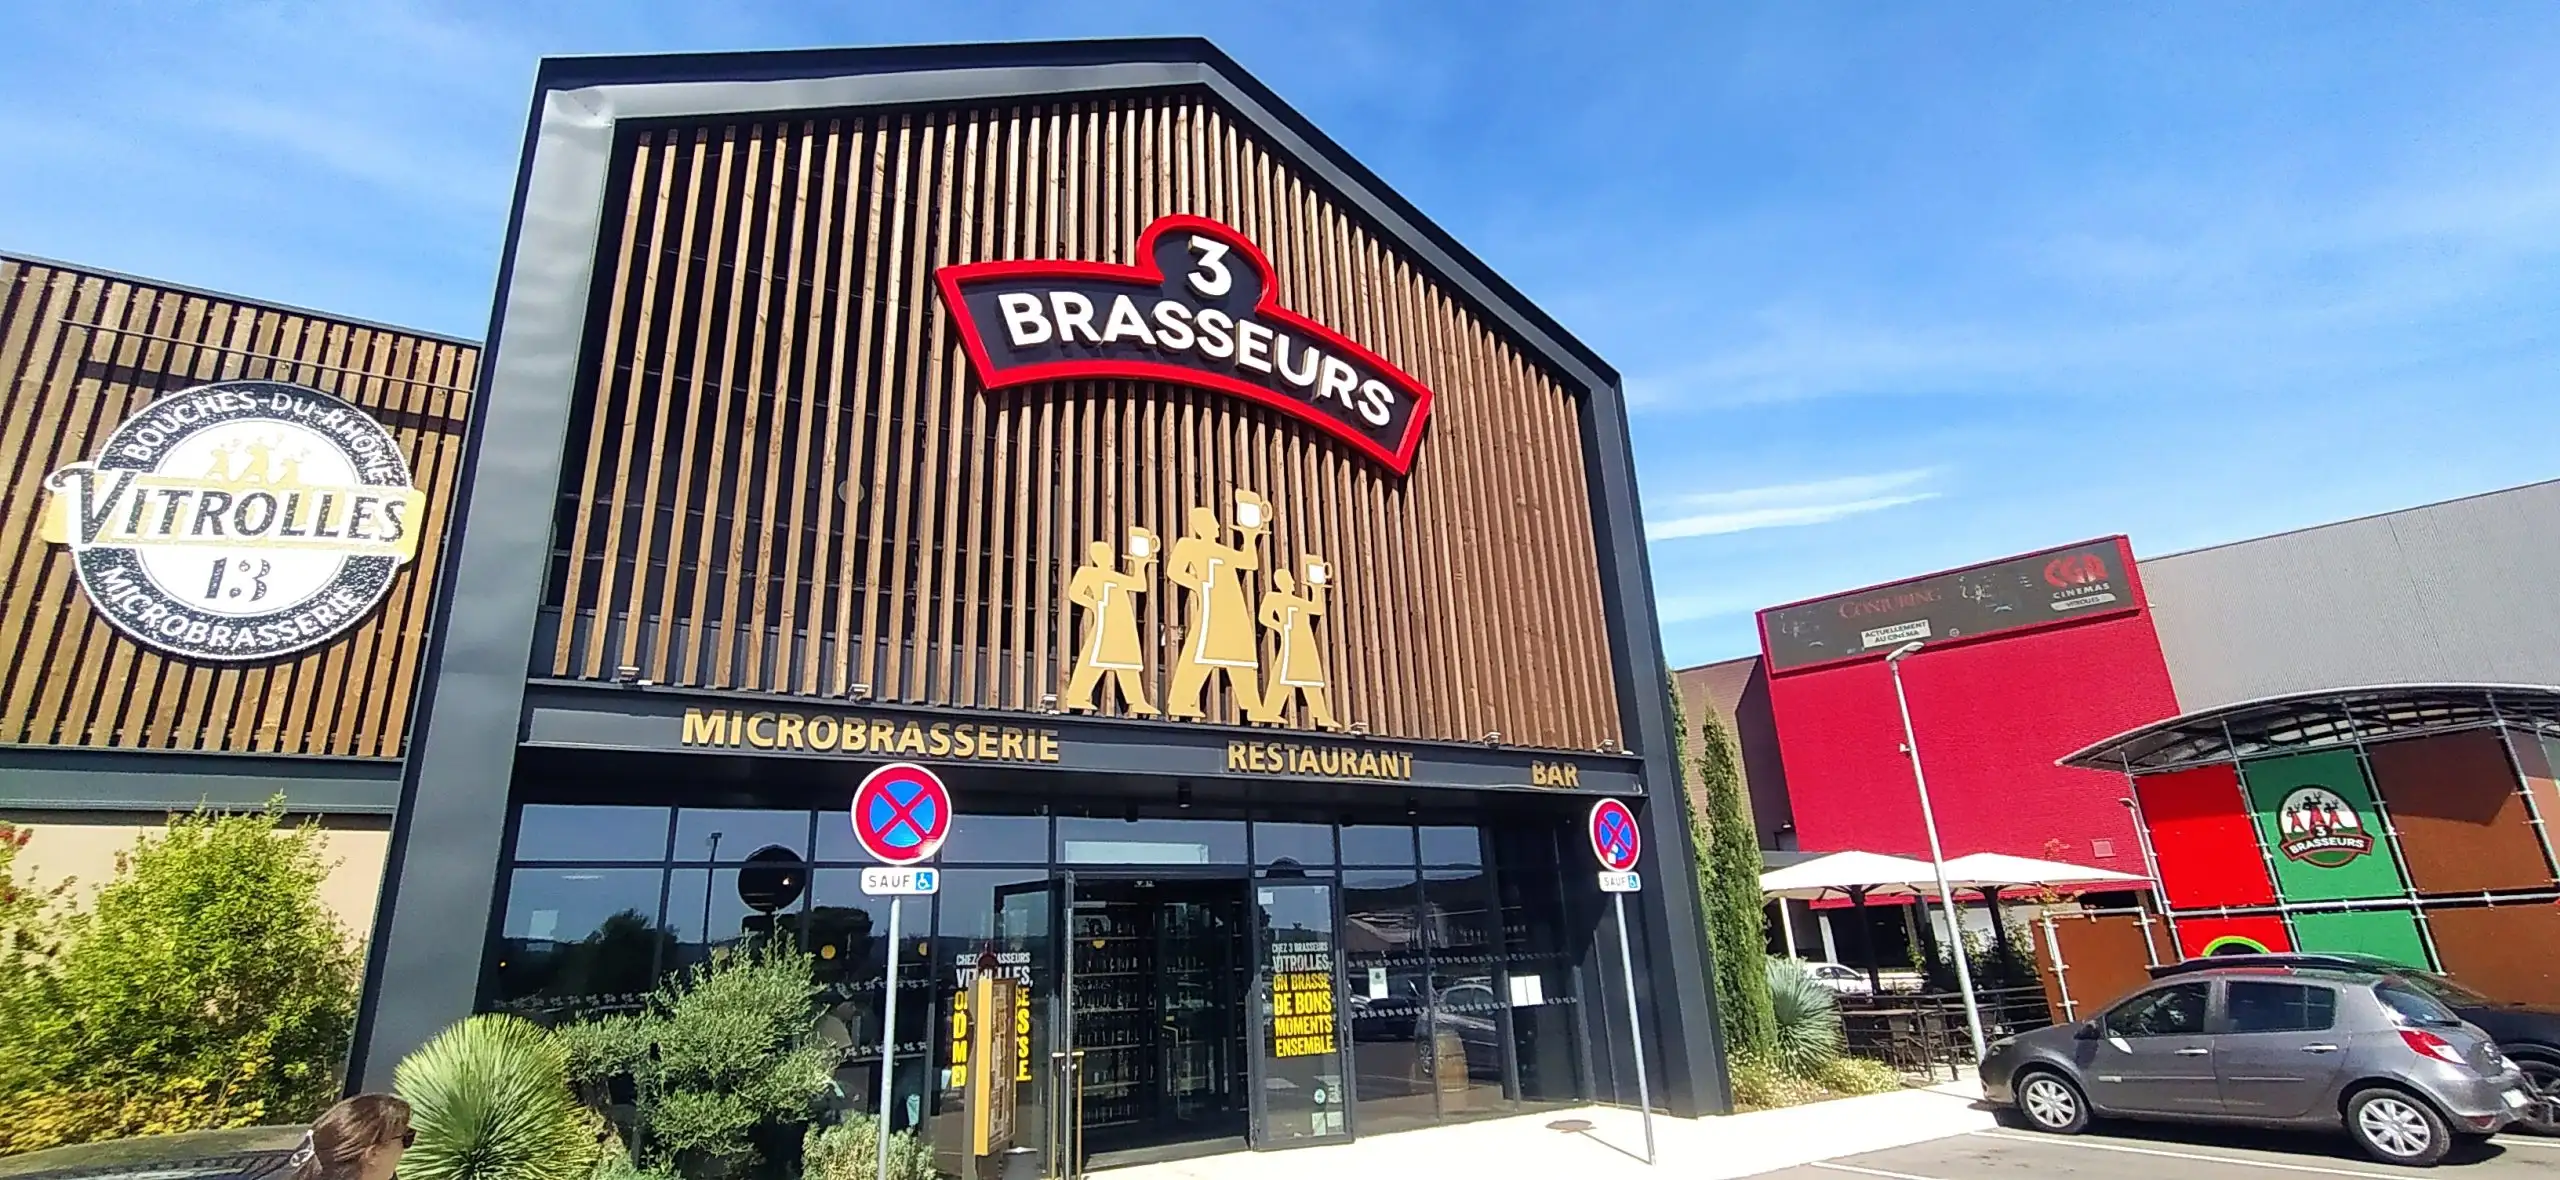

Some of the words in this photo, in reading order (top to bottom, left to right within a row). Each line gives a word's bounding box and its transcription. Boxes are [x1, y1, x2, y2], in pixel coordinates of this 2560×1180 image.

[1186, 234, 1232, 297] 3
[997, 291, 1396, 428] BRASSEURS
[48, 466, 408, 547] VITROLLES
[203, 556, 271, 603] 13
[2052, 582, 2111, 600] CINEMAS
[96, 565, 365, 648] MICROBRASSERIE
[1864, 621, 1927, 639] ACTUELLEMENT
[1874, 635, 1887, 643] AU
[681, 707, 1061, 763] MICROBRASSERIE
[1228, 740, 1414, 780] RESTAURANT
[1530, 760, 1581, 789] BAR
[2316, 825, 2327, 837] 3
[2288, 837, 2366, 854] BRASSEURS
[867, 873, 911, 889] SAUF
[1603, 876, 1627, 888] SAUF
[1273, 974, 1288, 991] ON
[1291, 972, 1330, 990] BRASSE
[1274, 993, 1292, 1015] DE
[1295, 991, 1332, 1014] BONS
[1275, 1015, 1333, 1037] MOMENTS
[1276, 1035, 1336, 1057] ENSEMBLE.
